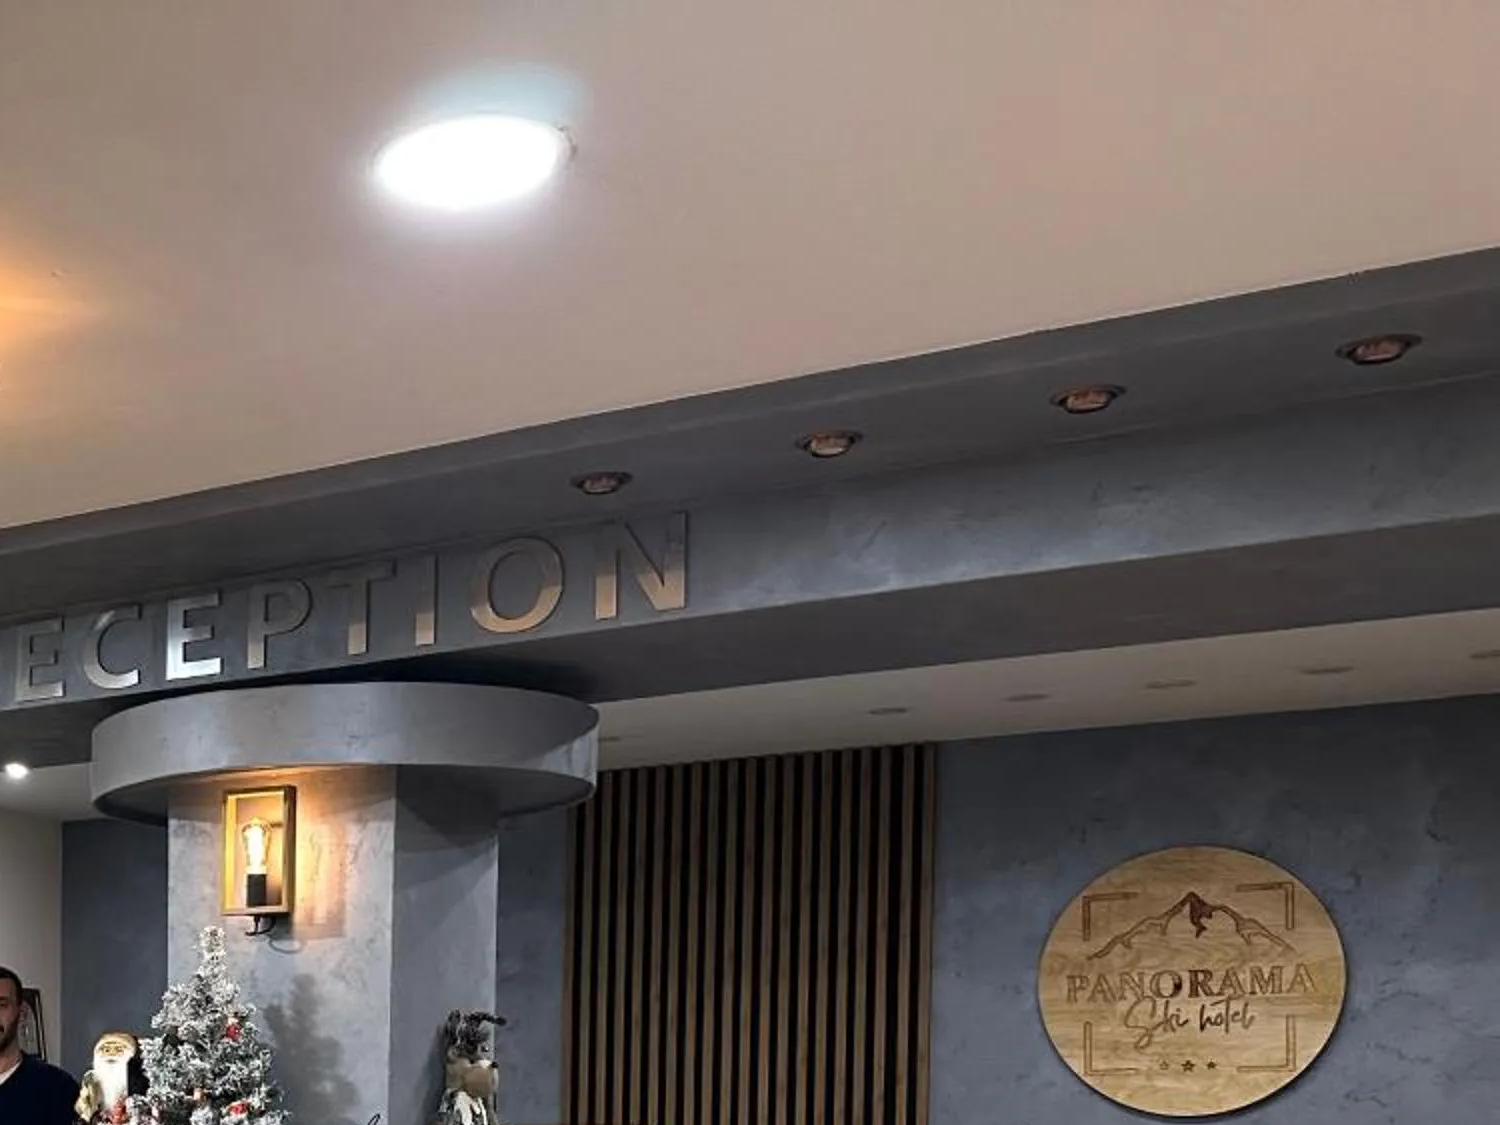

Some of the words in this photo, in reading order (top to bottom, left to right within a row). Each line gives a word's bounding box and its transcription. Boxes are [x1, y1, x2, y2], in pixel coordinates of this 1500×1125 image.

[1066, 963, 1318, 1002] PANORAMA
[1124, 996, 1189, 1050] Ski
[1200, 996, 1255, 1034] hotel
